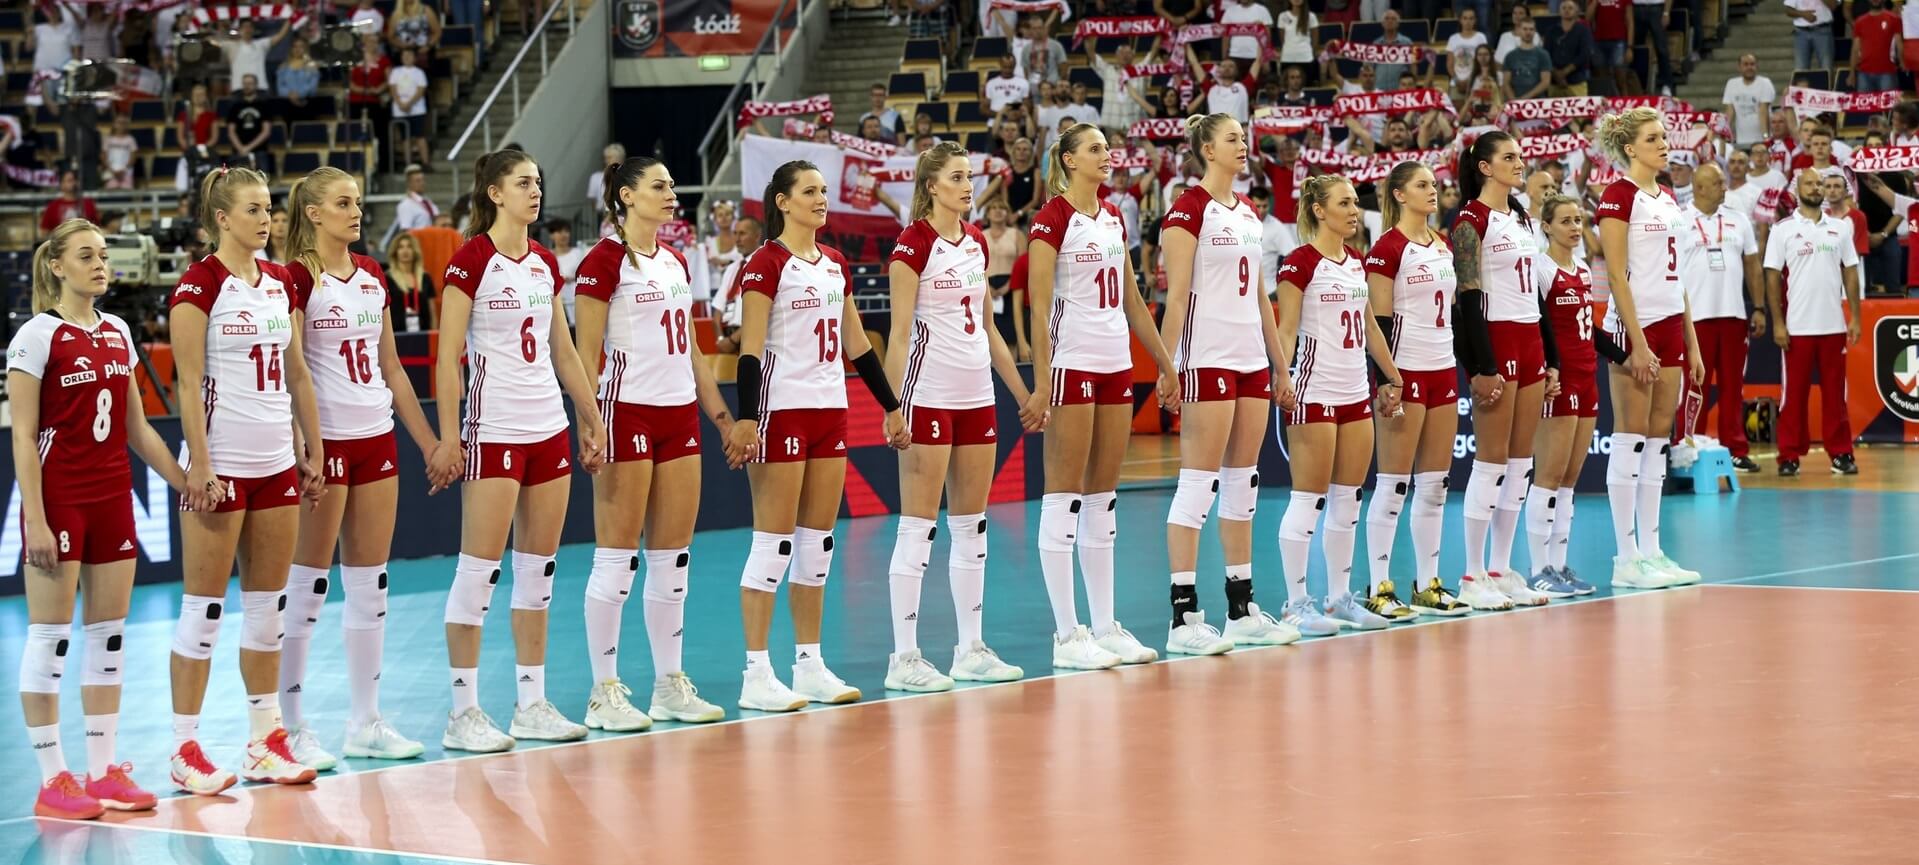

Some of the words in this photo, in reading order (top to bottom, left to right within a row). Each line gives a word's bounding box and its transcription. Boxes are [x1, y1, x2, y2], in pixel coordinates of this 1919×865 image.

[694, 14, 742, 34] Łódź
[1338, 90, 1434, 112] POLSKA
[1504, 98, 1598, 119] POLSKA
[1168, 211, 1184, 220] plus
[1494, 244, 1517, 252] ORLEN
[1668, 236, 1677, 272] 5
[1077, 254, 1102, 262] ORLEN
[1239, 256, 1249, 296] 9
[1408, 274, 1433, 284] ORLEN
[1514, 256, 1532, 293] 17
[175, 282, 194, 296] plus
[637, 292, 664, 302] ORLEN
[1094, 266, 1119, 309] 10
[1352, 288, 1368, 300] plu
[528, 292, 551, 308] plus
[793, 300, 820, 308] ORLEN
[828, 290, 842, 306] plu
[357, 310, 381, 326] plus
[1434, 290, 1444, 327] 2
[224, 326, 256, 334] ORLEN
[315, 320, 346, 328] ORLEN
[660, 308, 687, 355] 18
[1341, 310, 1364, 348] 20
[1576, 306, 1593, 340] 13
[520, 316, 536, 363] 6
[814, 318, 838, 362] 15
[104, 360, 130, 379] plus
[248, 343, 280, 392] 14
[339, 338, 372, 384] 16
[1506, 360, 1516, 376] 17
[62, 372, 96, 386] ORLEN
[1217, 377, 1226, 394] 9
[1080, 381, 1093, 398] 10
[1412, 382, 1420, 398] 2
[1570, 394, 1579, 410] 13
[92, 388, 112, 442] 8
[931, 420, 940, 438] 3
[632, 434, 647, 453] 18
[784, 436, 799, 455] 15
[328, 457, 344, 478] 16
[504, 450, 512, 470] 6
[59, 530, 70, 553] 8
